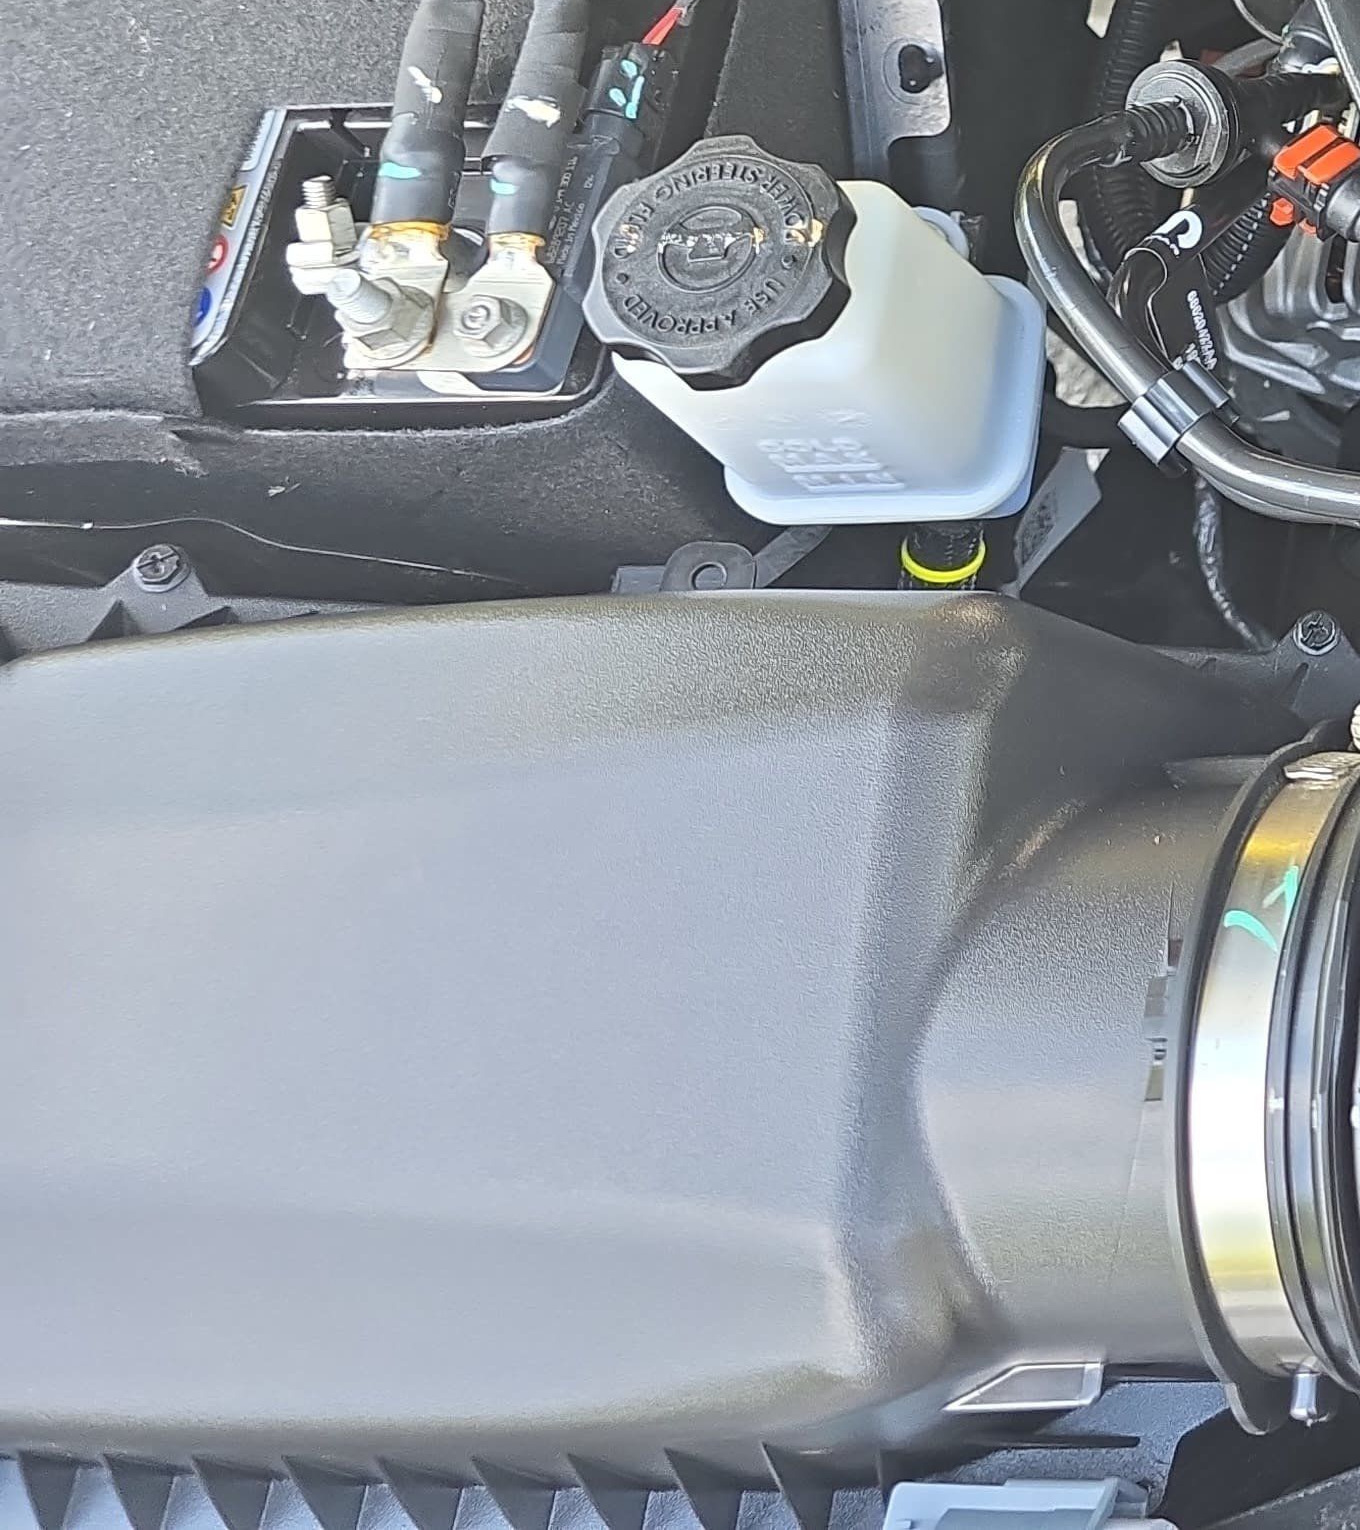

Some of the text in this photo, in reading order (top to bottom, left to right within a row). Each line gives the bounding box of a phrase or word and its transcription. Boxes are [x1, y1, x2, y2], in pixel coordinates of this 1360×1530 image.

[655, 161, 762, 201] STEERING
[622, 277, 787, 335] USE APPROVED
